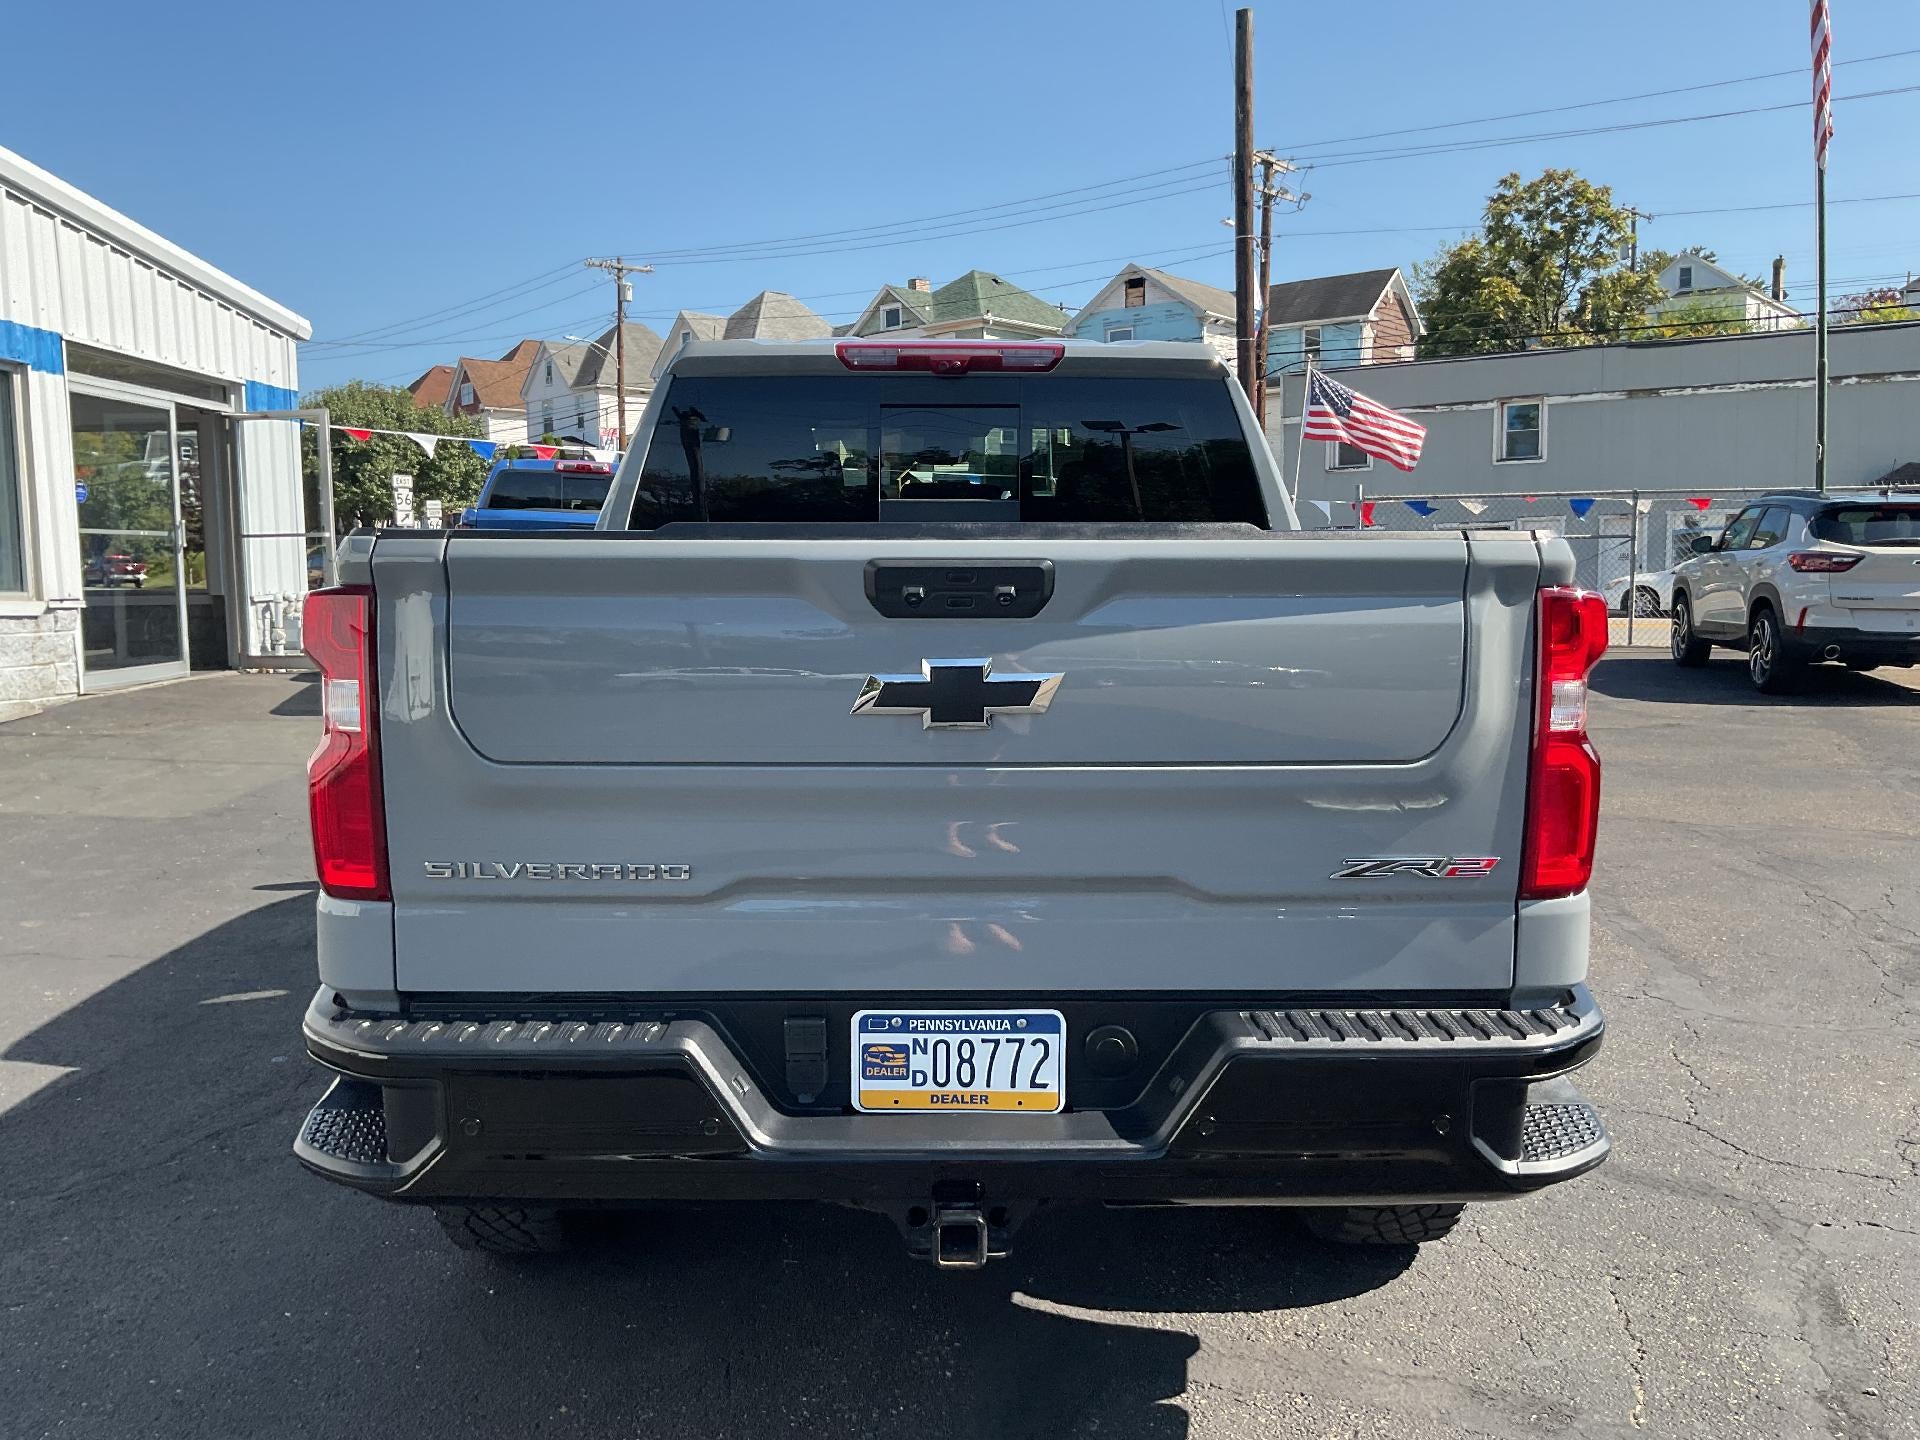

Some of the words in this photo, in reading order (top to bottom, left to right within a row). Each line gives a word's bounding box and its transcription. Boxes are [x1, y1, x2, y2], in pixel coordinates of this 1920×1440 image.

[396, 477, 410, 485] EAST
[396, 493, 412, 506] 56
[424, 861, 691, 880] SILVERADO
[1330, 857, 1501, 879] ZR2
[909, 1019, 1011, 1031] PENNSYLVANIA
[932, 1037, 1051, 1089] 08772
[866, 1067, 907, 1076] DEALER
[930, 1094, 989, 1105] DEALER
